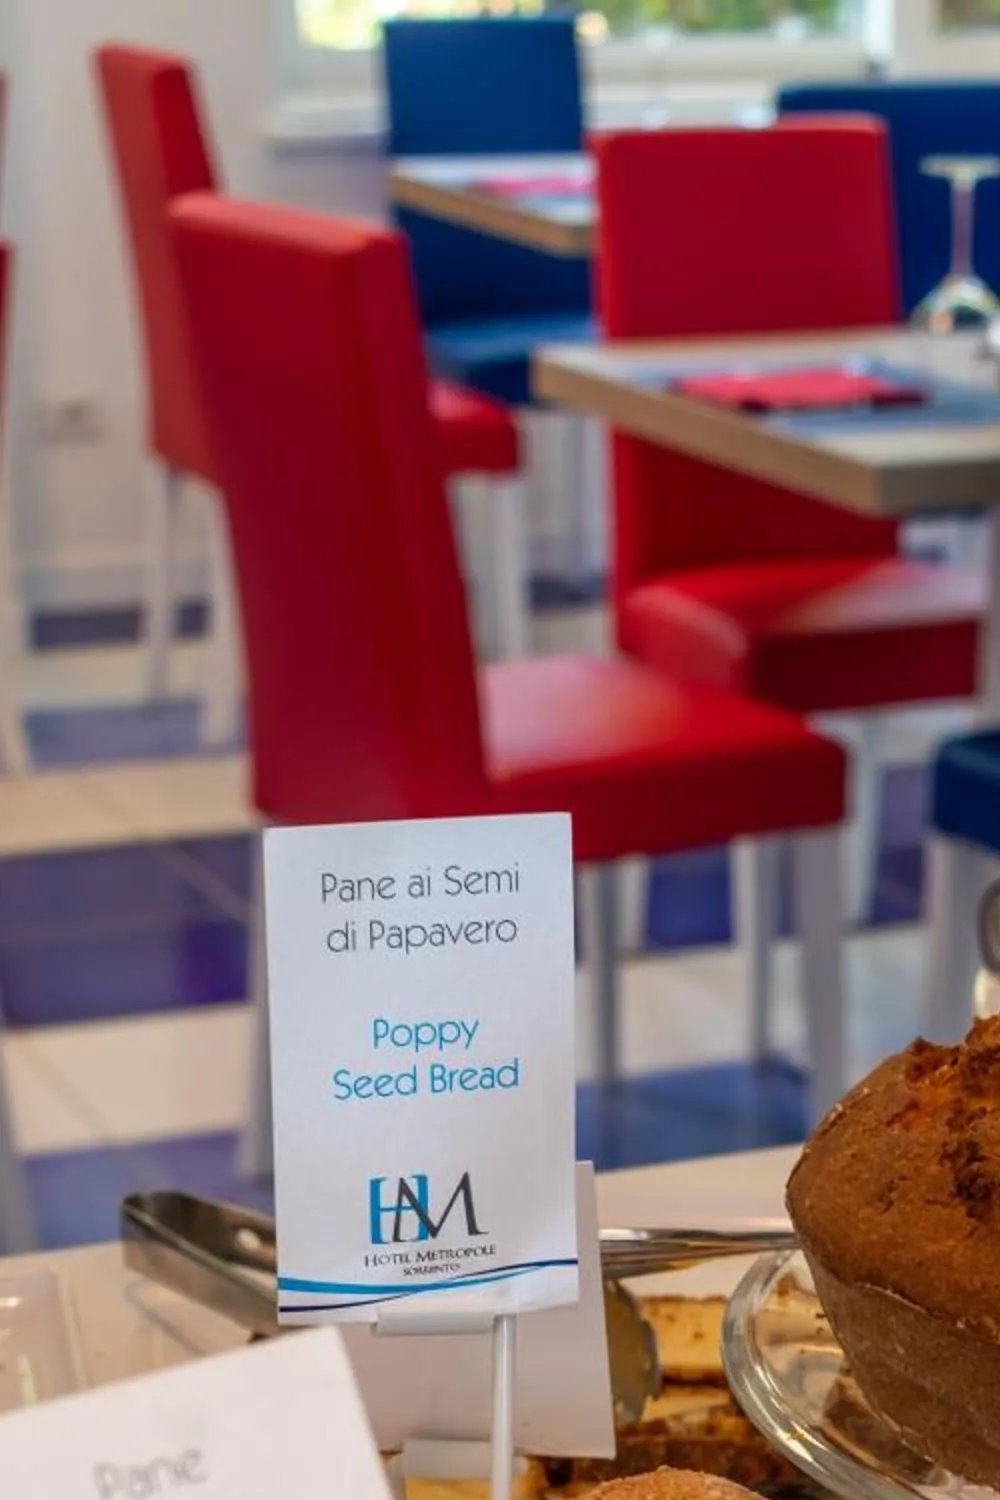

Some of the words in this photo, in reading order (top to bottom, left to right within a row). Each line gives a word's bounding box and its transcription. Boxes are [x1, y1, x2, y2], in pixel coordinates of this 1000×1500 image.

[320, 872, 396, 903] Pane
[407, 866, 431, 899] ai
[443, 862, 519, 896] Semi
[326, 921, 356, 952] di
[368, 918, 517, 954] Papavero
[373, 1018, 479, 1051] Poppy
[332, 1065, 417, 1100] Seed
[429, 1057, 519, 1094] Bread
[364, 1252, 412, 1269] HOTEL
